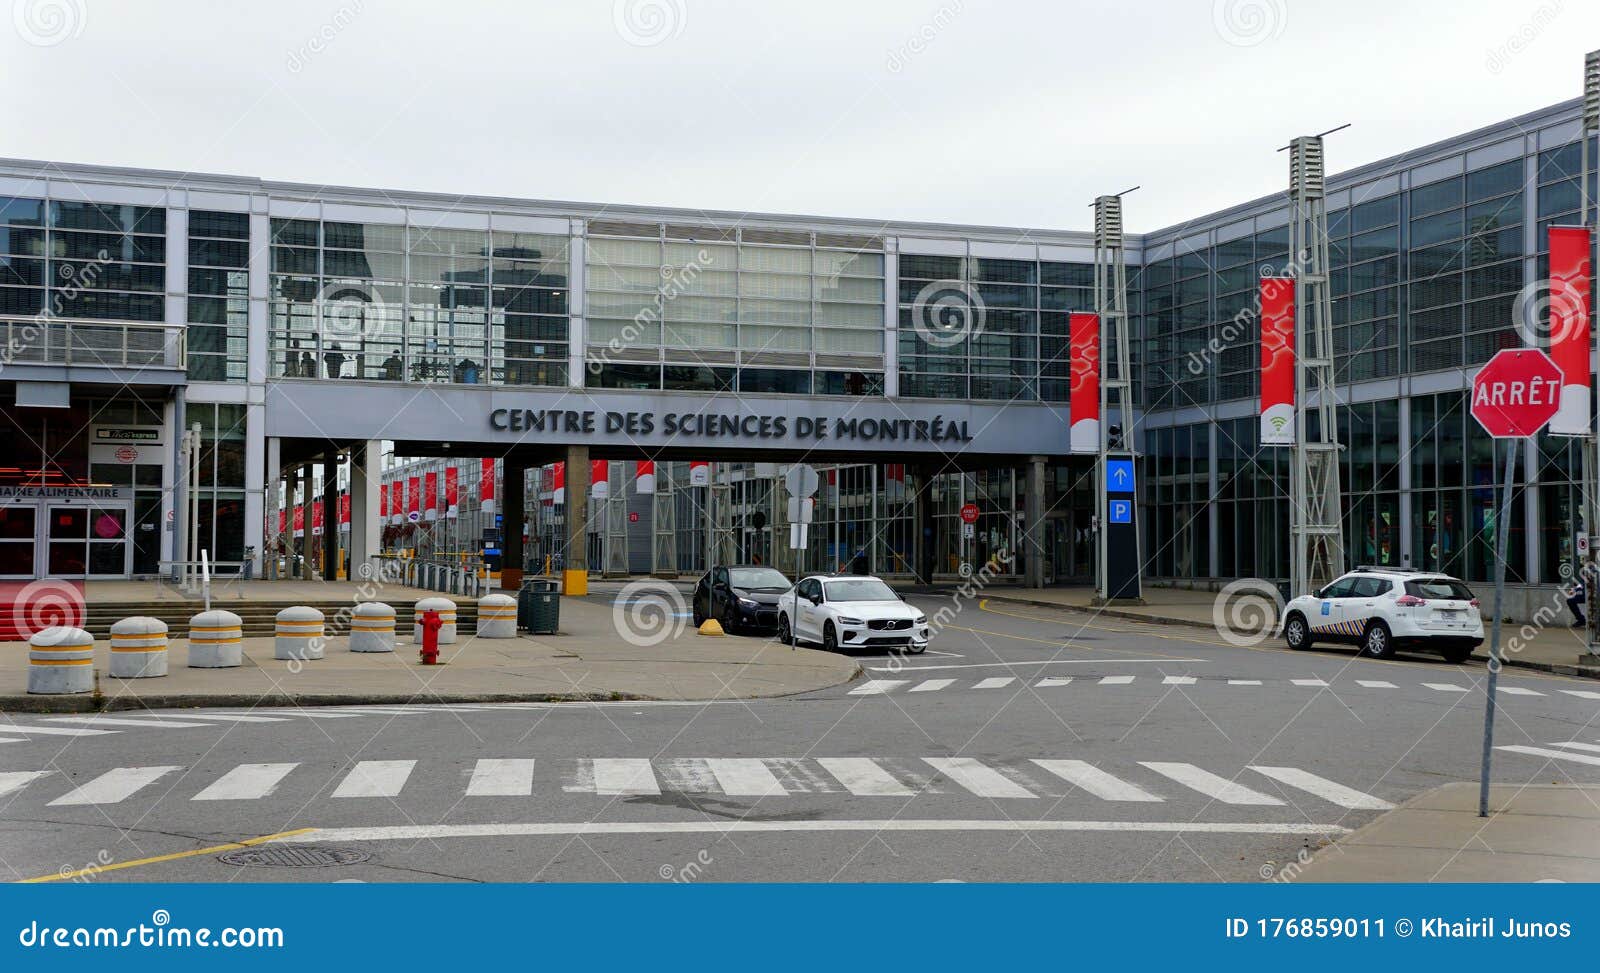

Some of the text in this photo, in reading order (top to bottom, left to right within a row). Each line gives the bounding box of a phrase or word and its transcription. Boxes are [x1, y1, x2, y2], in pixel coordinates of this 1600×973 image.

[1475, 375, 1559, 406] ARRÊT
[489, 409, 973, 443] CENTRE DES SCIENCES DE MONTRÉAL
[0, 487, 119, 498] AINE ALIMENTAIRE
[1115, 503, 1126, 520] P
